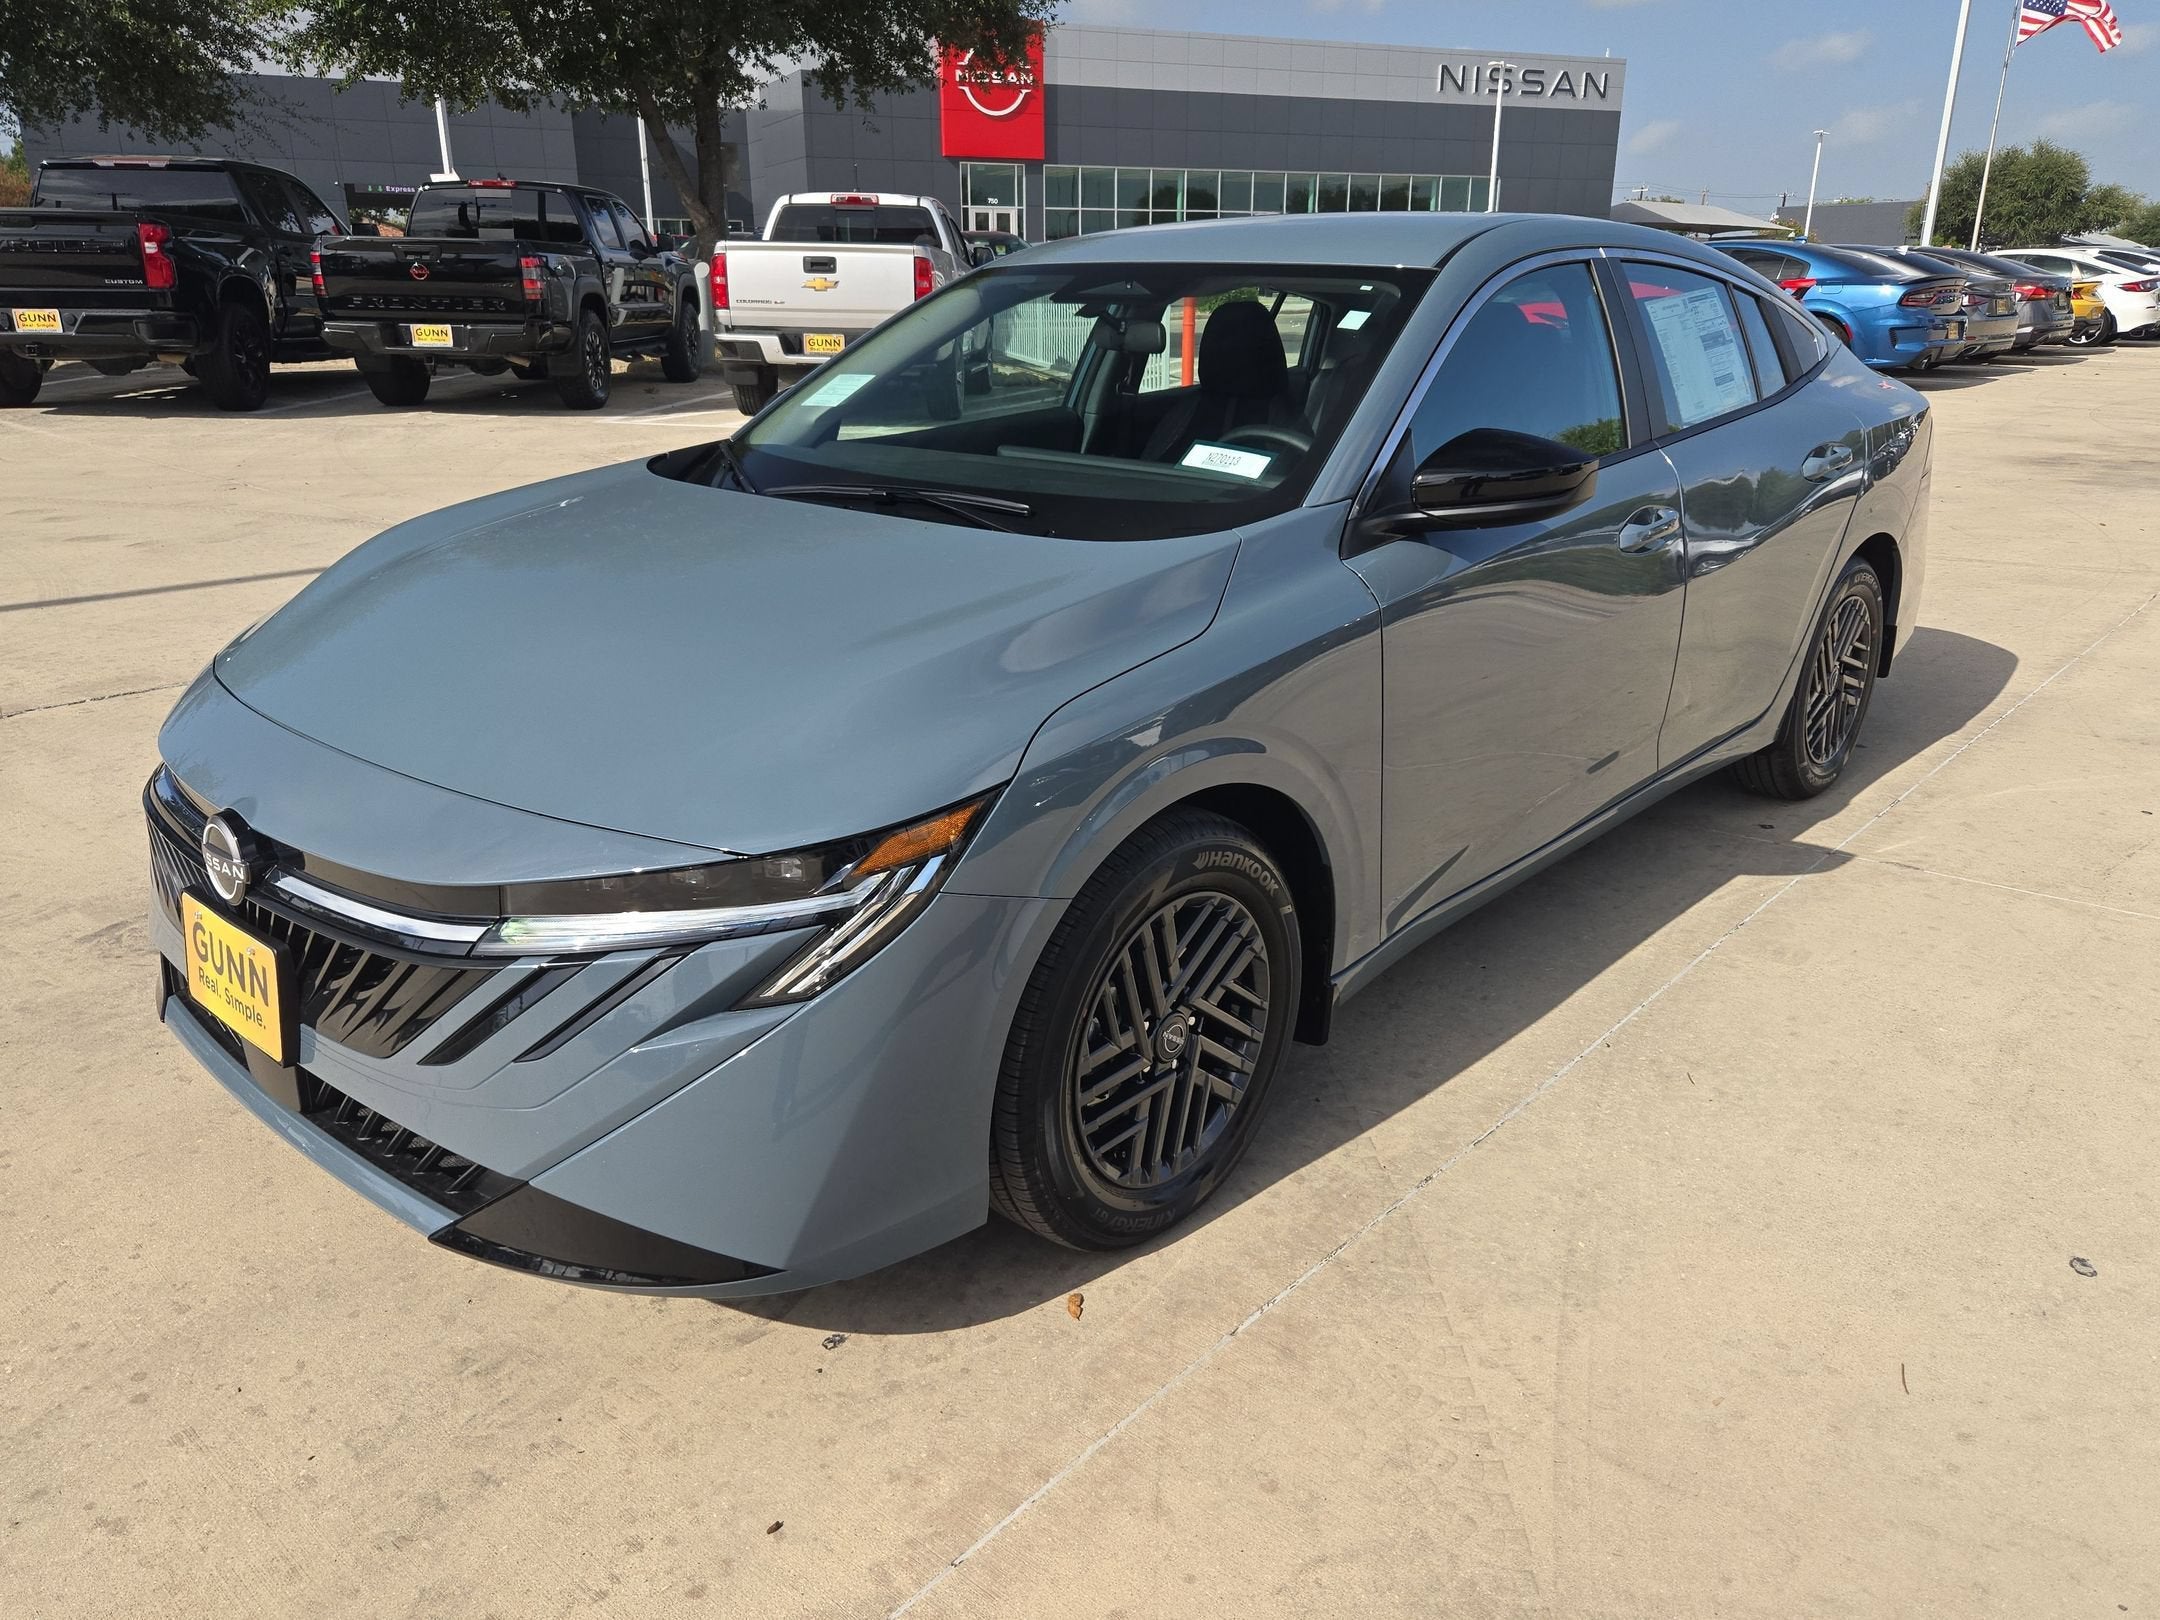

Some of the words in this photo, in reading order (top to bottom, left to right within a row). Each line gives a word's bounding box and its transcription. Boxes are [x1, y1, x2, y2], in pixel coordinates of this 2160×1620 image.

[1437, 64, 1609, 99] NISSAN
[385, 185, 416, 193] Express
[18, 312, 57, 323] GUNN
[415, 328, 448, 337] GUNN
[808, 338, 841, 348] GUNN
[192, 921, 269, 1008] GUNN
[198, 965, 222, 999] Real.
[225, 987, 267, 1030] Simple.
